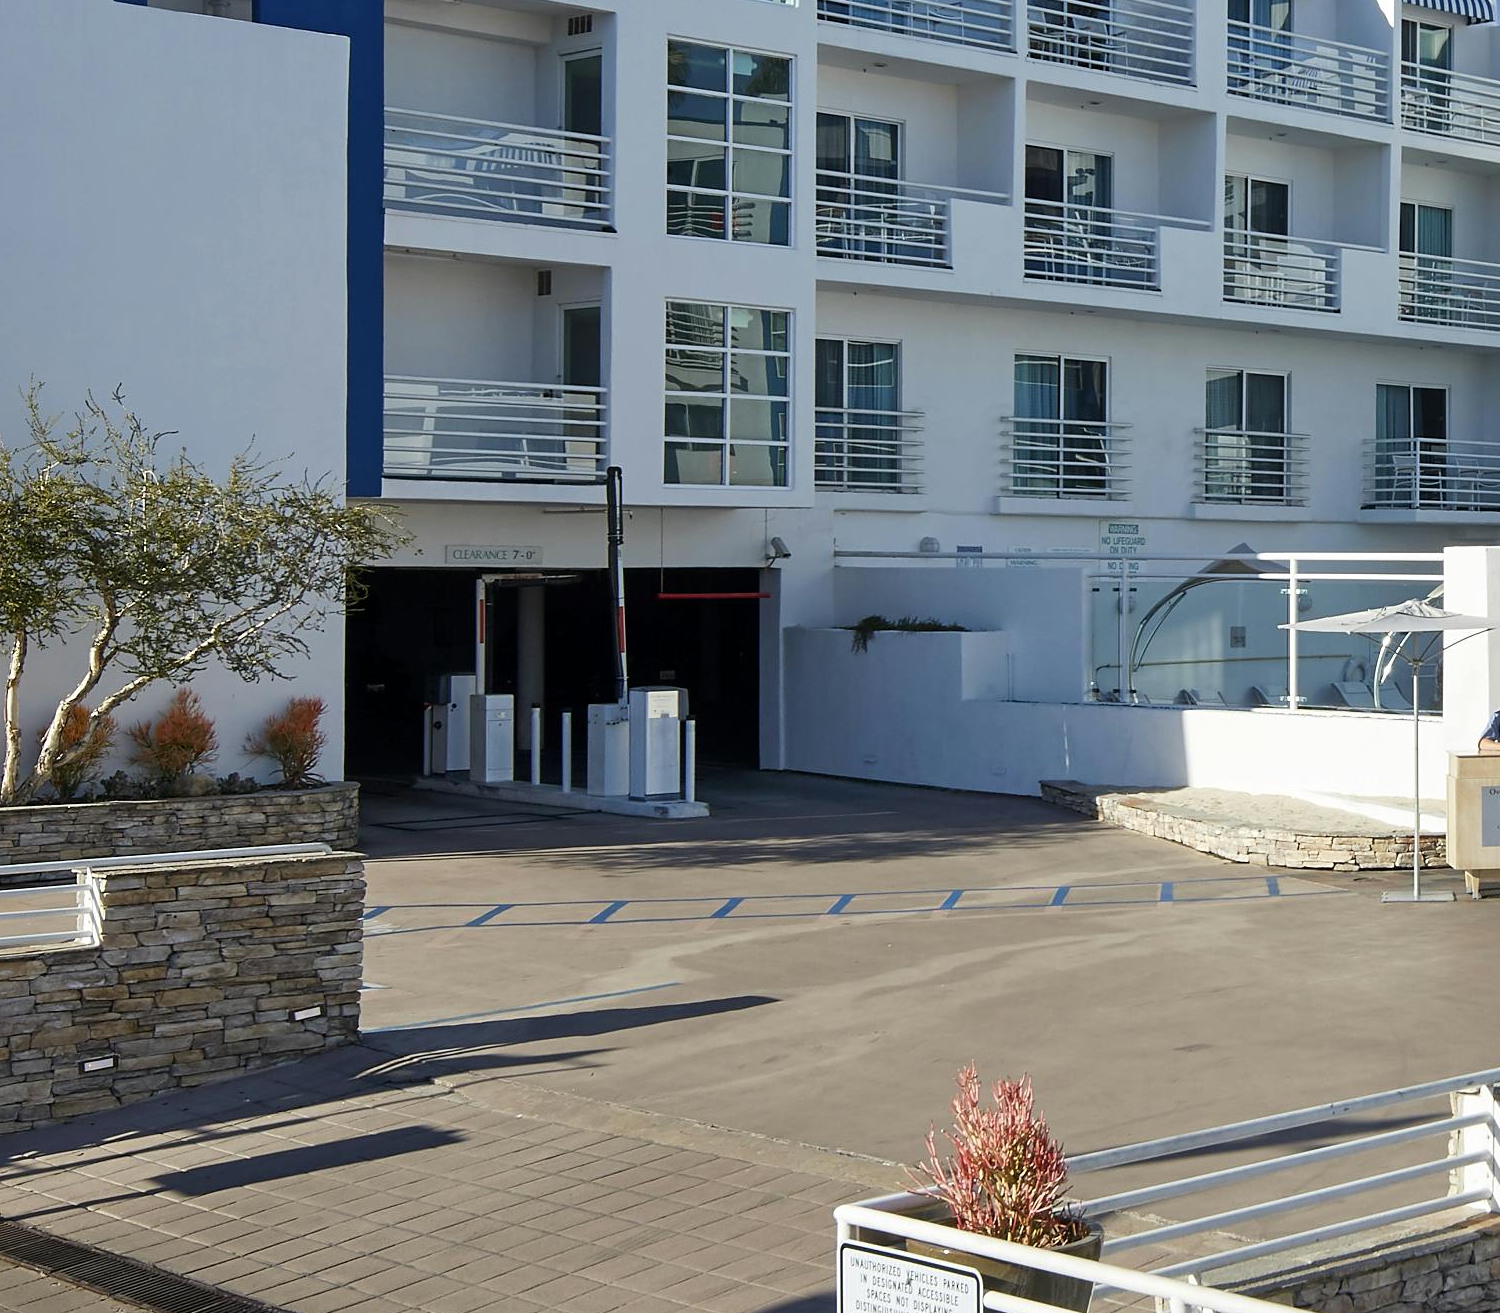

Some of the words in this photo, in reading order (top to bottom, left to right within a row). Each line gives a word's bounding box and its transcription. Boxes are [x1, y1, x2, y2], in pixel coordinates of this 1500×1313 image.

[452, 549, 507, 559] CLEARANCE
[851, 1256, 901, 1277] UNAUTHORIZED
[907, 1270, 938, 1286] VEHICLES
[943, 1278, 969, 1294] PARKED
[860, 1274, 867, 1283] IN
[873, 1276, 912, 1294] DESIGNATED
[918, 1287, 958, 1306] ACCESSIBLE
[867, 1289, 891, 1303] SPACES
[897, 1296, 908, 1307] NOT
